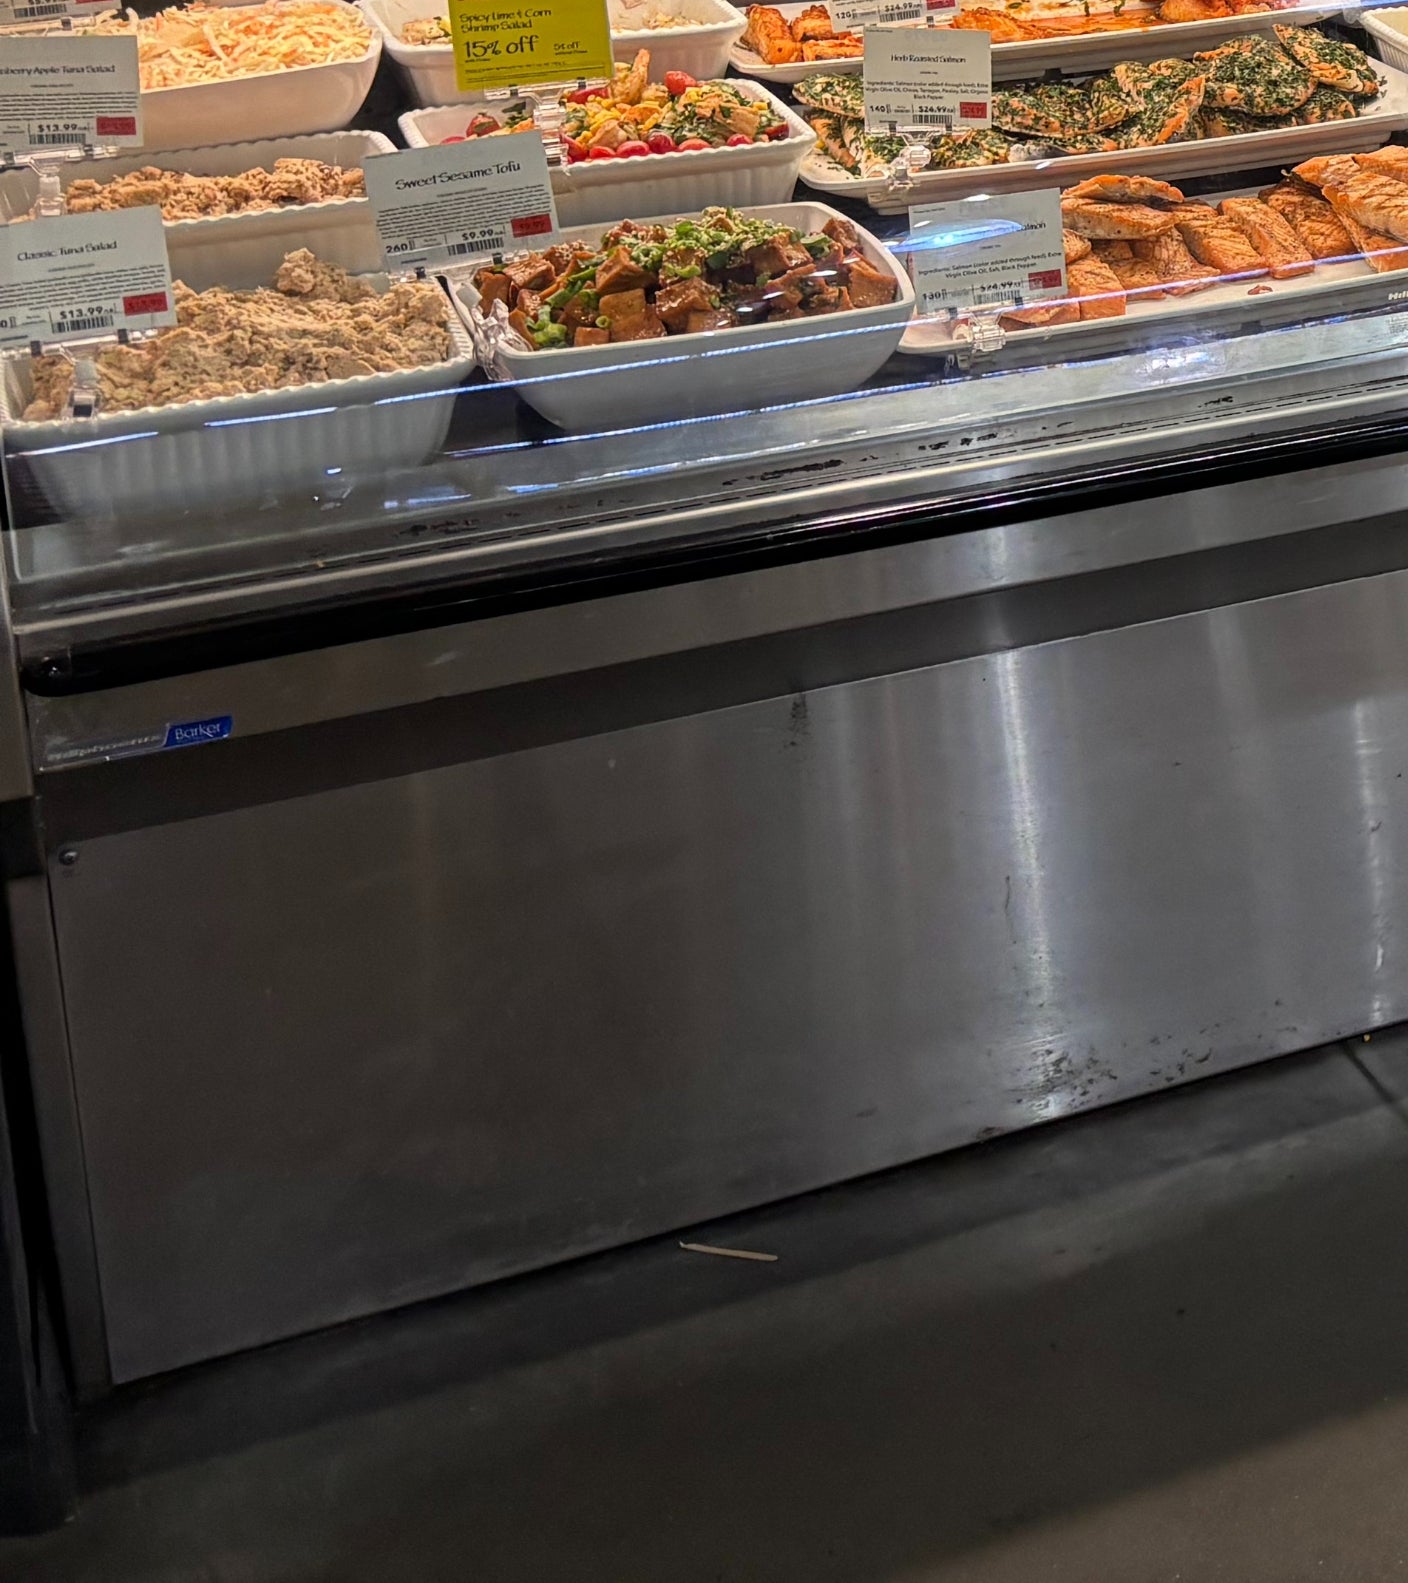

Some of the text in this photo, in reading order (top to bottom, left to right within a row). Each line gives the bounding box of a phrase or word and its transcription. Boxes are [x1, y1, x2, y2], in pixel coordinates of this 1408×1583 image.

[460, 13, 490, 26] Spicy
[524, 8, 551, 18] Corn
[461, 19, 532, 33] Shrimp Salad
[465, 35, 539, 58] 15% off
[86, 65, 115, 73] Salad
[870, 105, 884, 113] 140
[395, 160, 521, 190] Sweet Sesame Tofu
[386, 229, 494, 253] 260 $9.99
[17, 240, 118, 262] Classic Tuna Salad
[60, 306, 103, 320] $13.99
[175, 722, 222, 741] Barker
